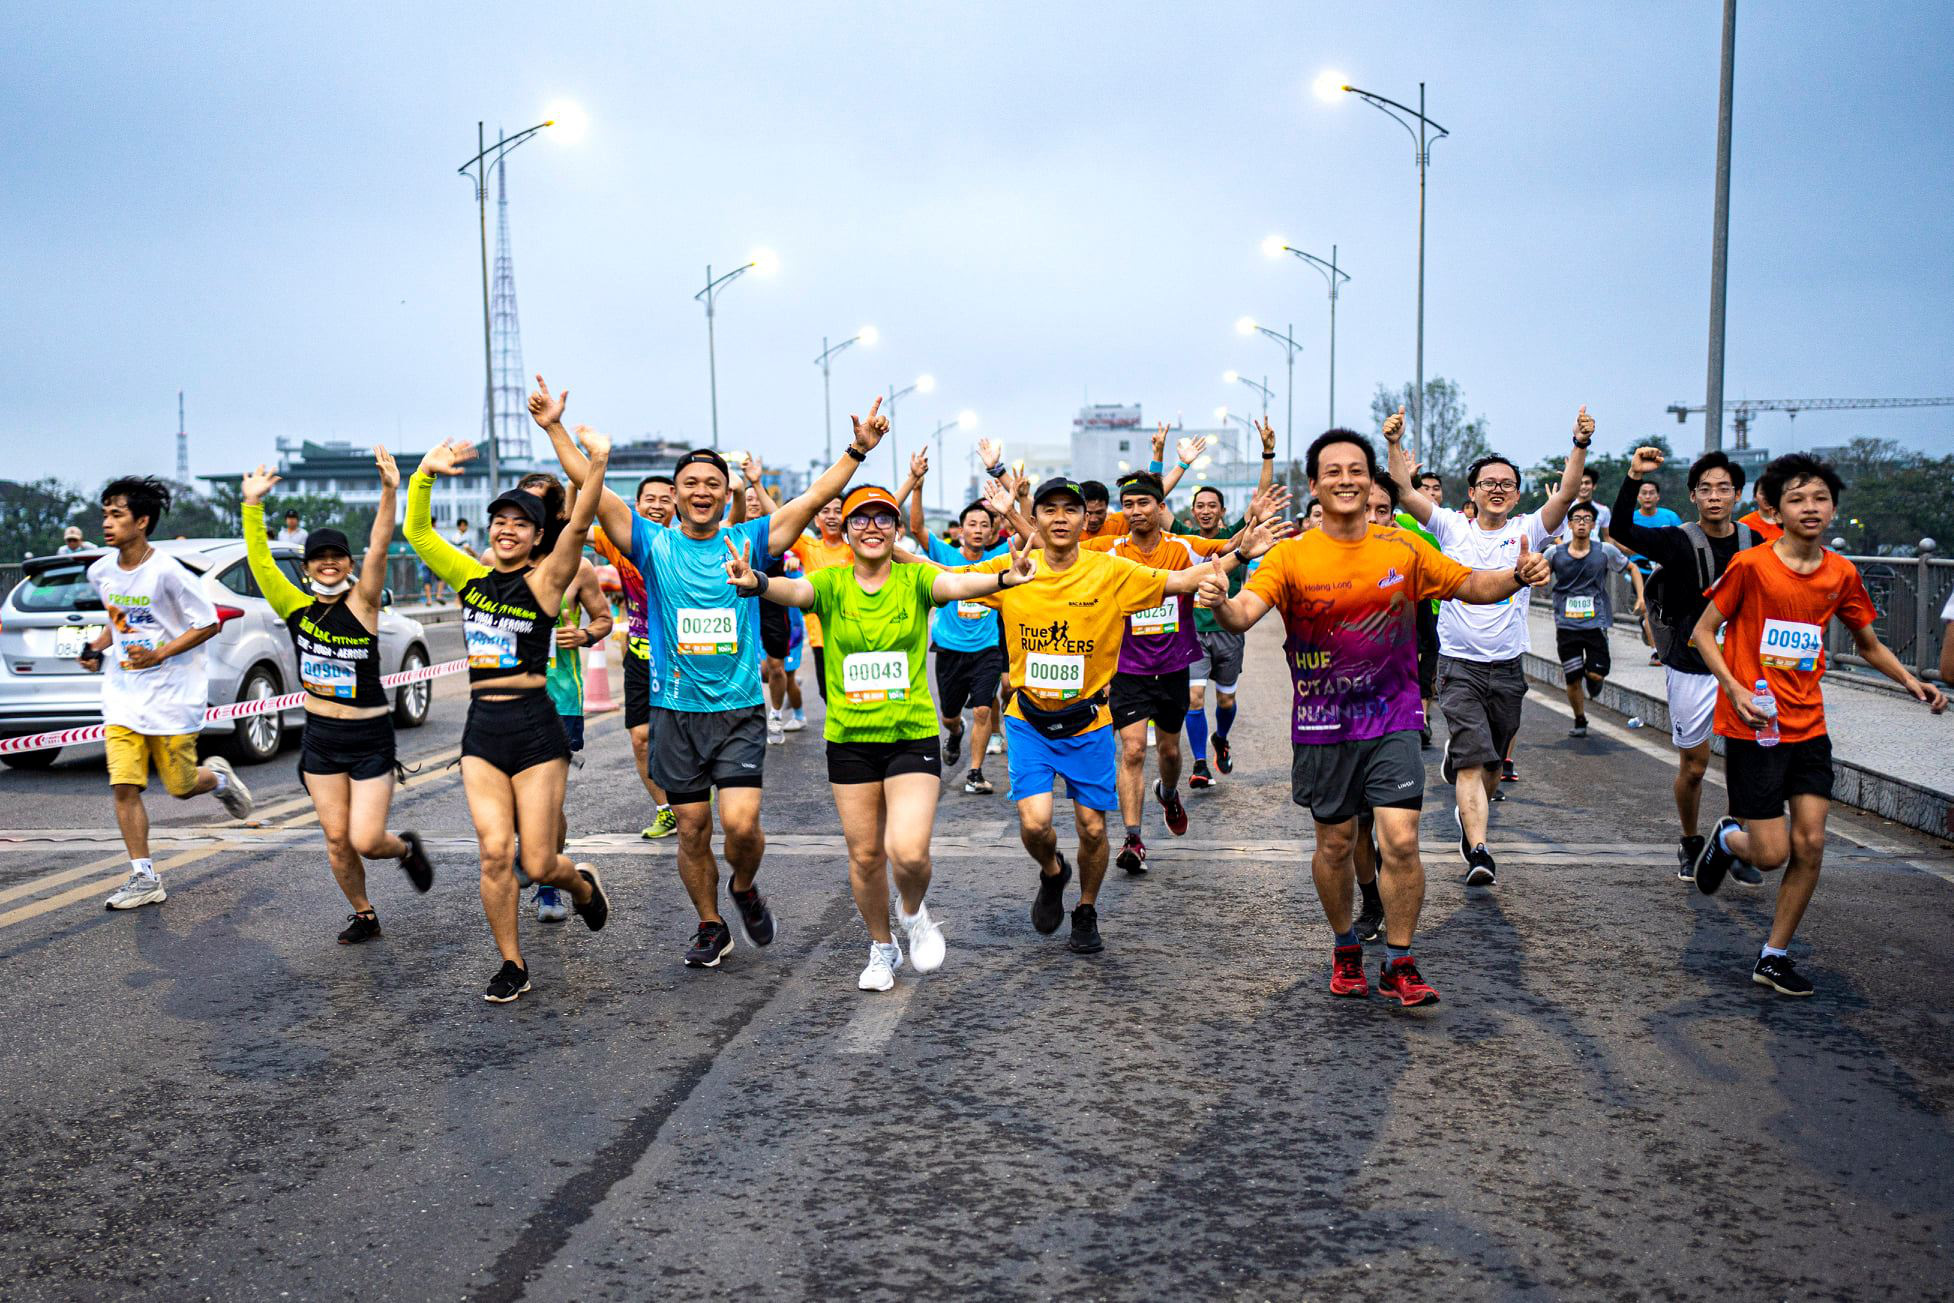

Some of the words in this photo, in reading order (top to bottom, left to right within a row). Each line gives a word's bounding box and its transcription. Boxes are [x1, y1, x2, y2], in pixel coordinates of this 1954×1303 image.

[1135, 604, 1175, 619] 00257
[1568, 599, 1591, 608] 00103
[129, 614, 155, 624] LIFE
[682, 617, 732, 634] 00228
[1019, 624, 1048, 638] True
[1767, 628, 1820, 650] 00934
[1295, 651, 1332, 670] HUE
[304, 661, 352, 678] 00904
[849, 661, 902, 681] 00043
[1031, 662, 1079, 680] 00088
